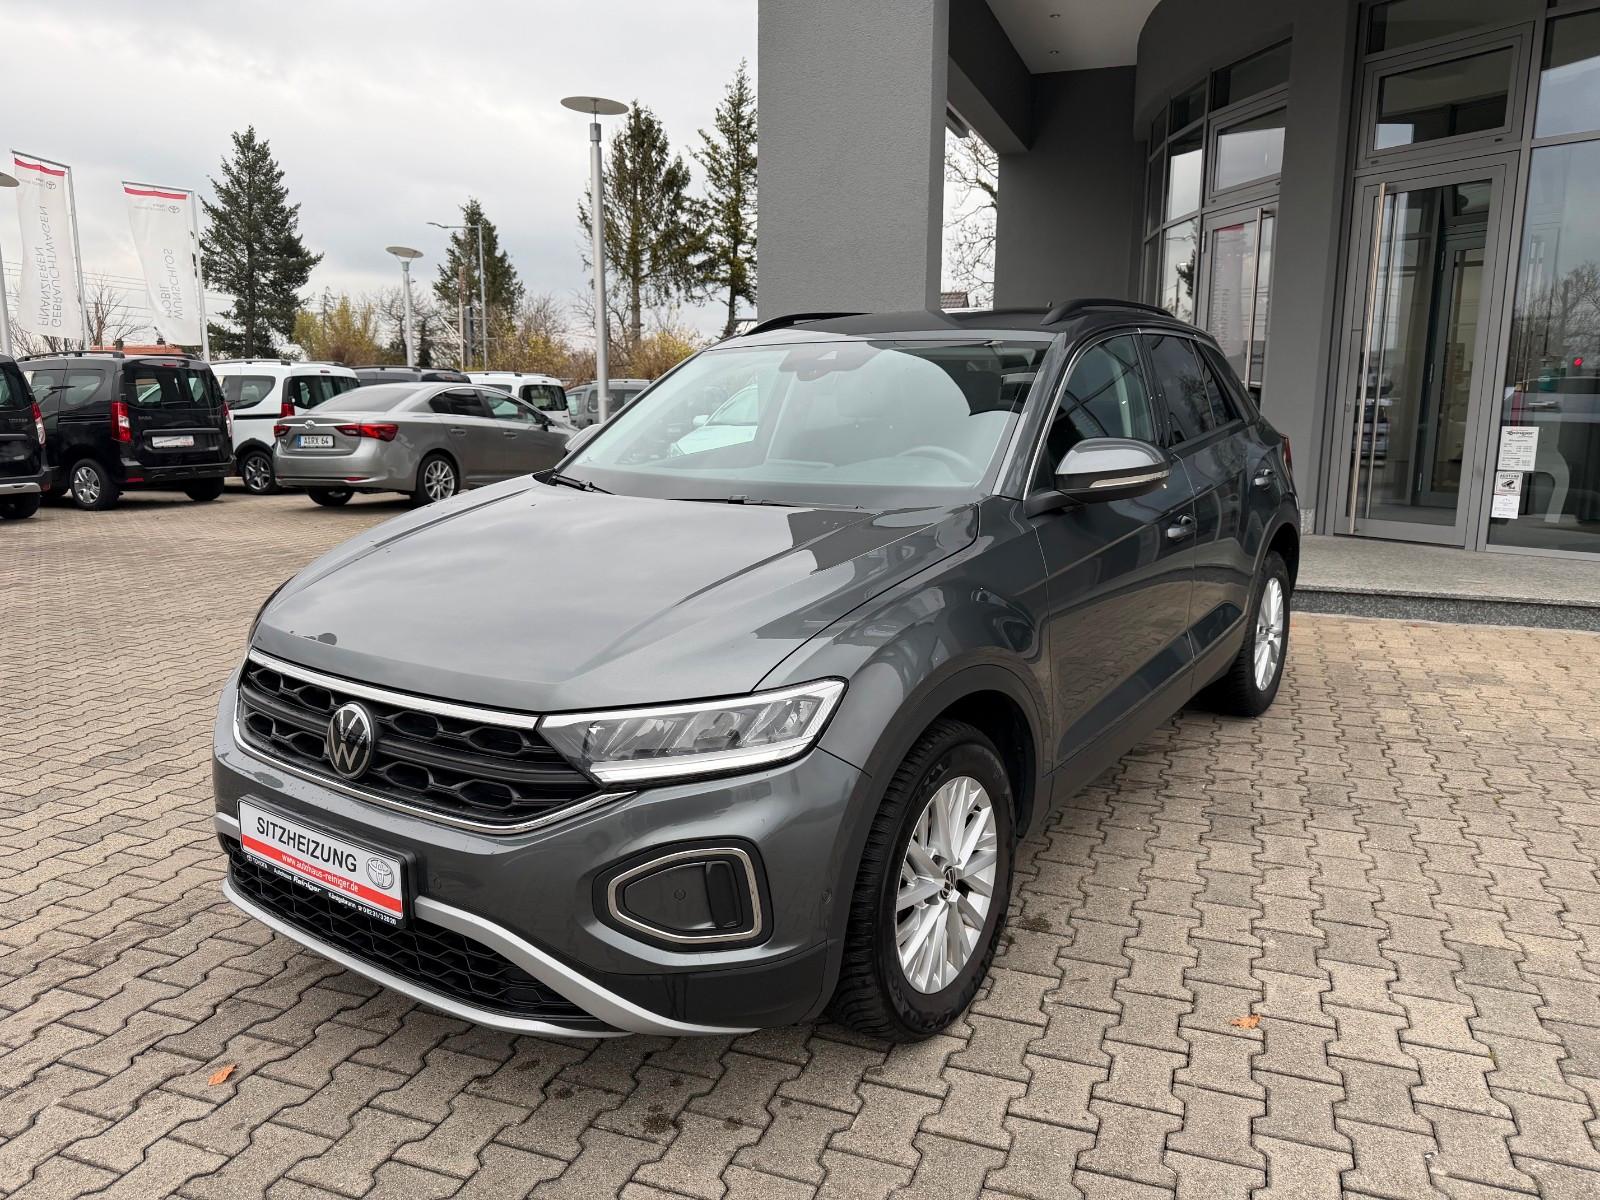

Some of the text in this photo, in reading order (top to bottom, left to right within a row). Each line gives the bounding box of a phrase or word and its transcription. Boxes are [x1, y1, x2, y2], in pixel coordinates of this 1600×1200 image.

[321, 436, 329, 444] 64
[256, 817, 357, 872] SITZHEIZUNG
[281, 853, 359, 892] www.autohaus-reiniger.de
[293, 875, 322, 892] Reiniger
